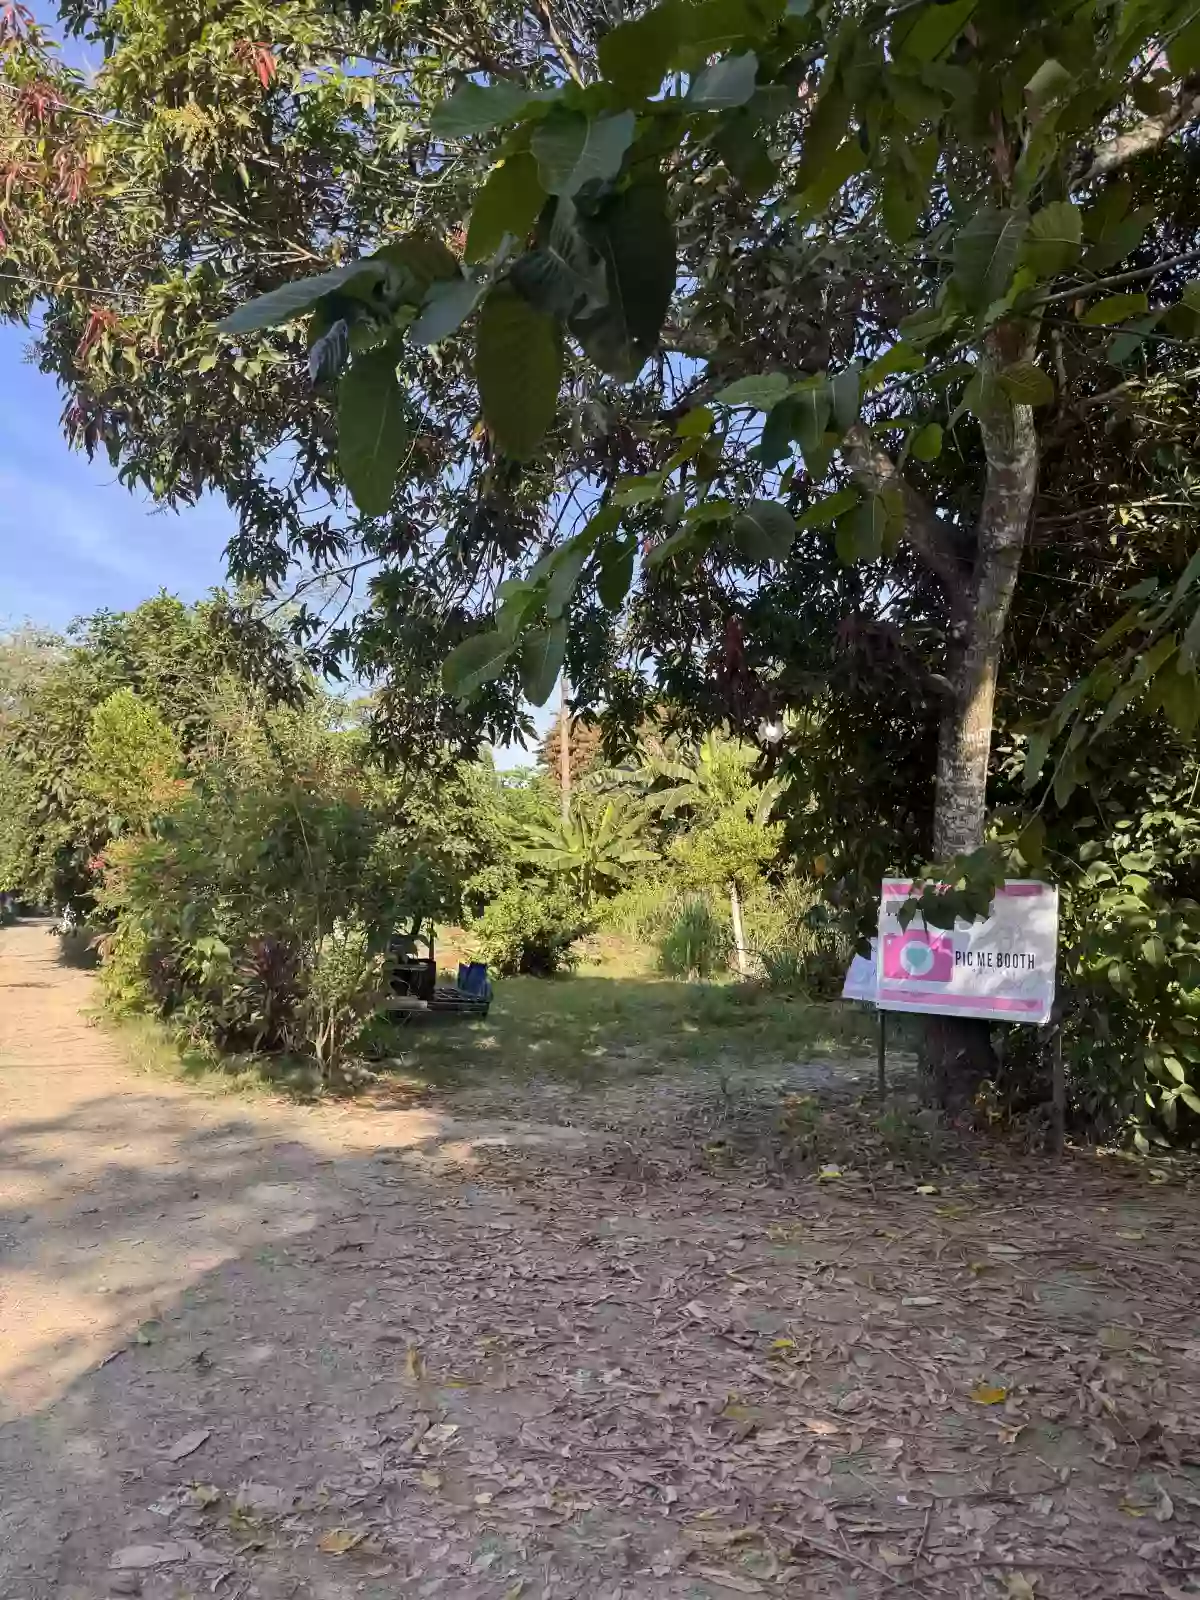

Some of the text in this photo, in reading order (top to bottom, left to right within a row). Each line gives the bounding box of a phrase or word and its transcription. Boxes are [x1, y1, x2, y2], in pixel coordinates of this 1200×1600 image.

[955, 950, 1035, 969] PIC ME BOOTH
